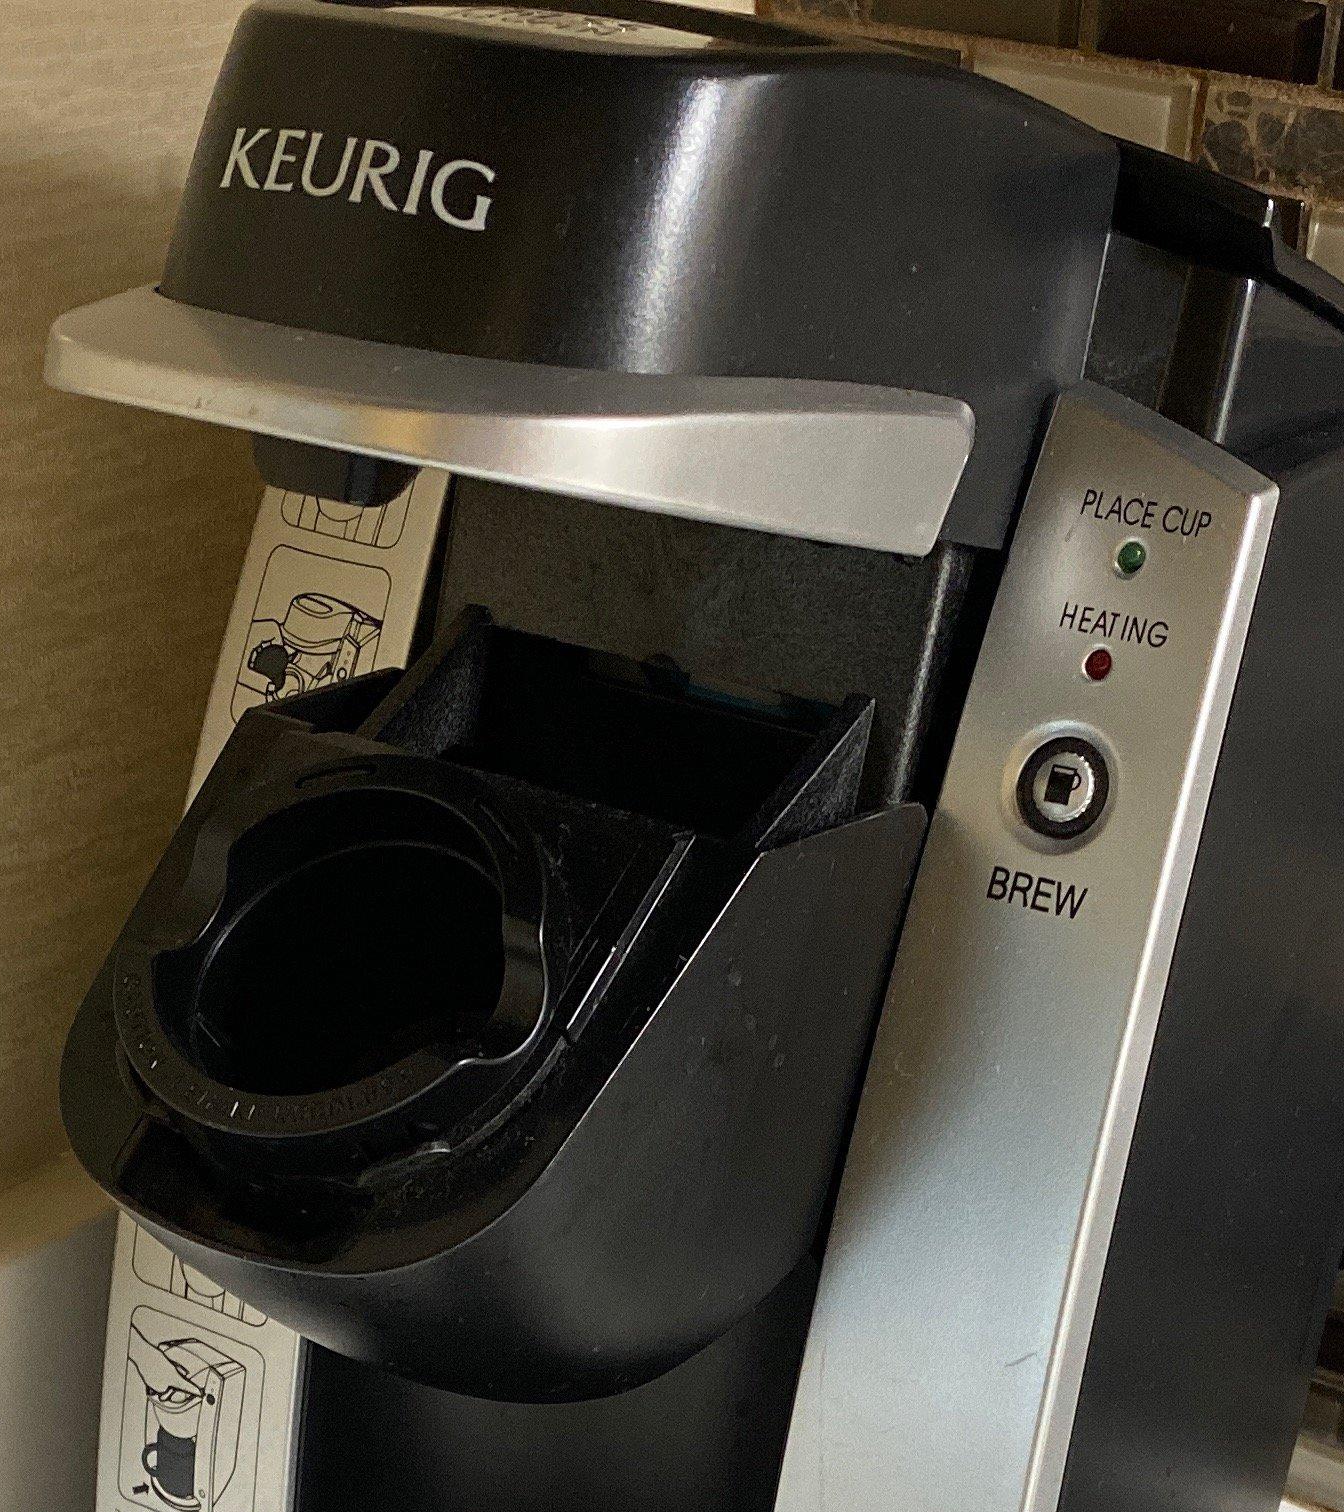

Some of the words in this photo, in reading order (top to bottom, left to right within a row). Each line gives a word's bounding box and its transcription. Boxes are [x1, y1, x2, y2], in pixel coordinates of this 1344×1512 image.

[219, 126, 496, 232] KEURIG
[1080, 489, 1158, 529] PLACE
[1162, 504, 1212, 539] CUP
[1059, 601, 1169, 648] HEATING
[986, 865, 1088, 920] BREW
